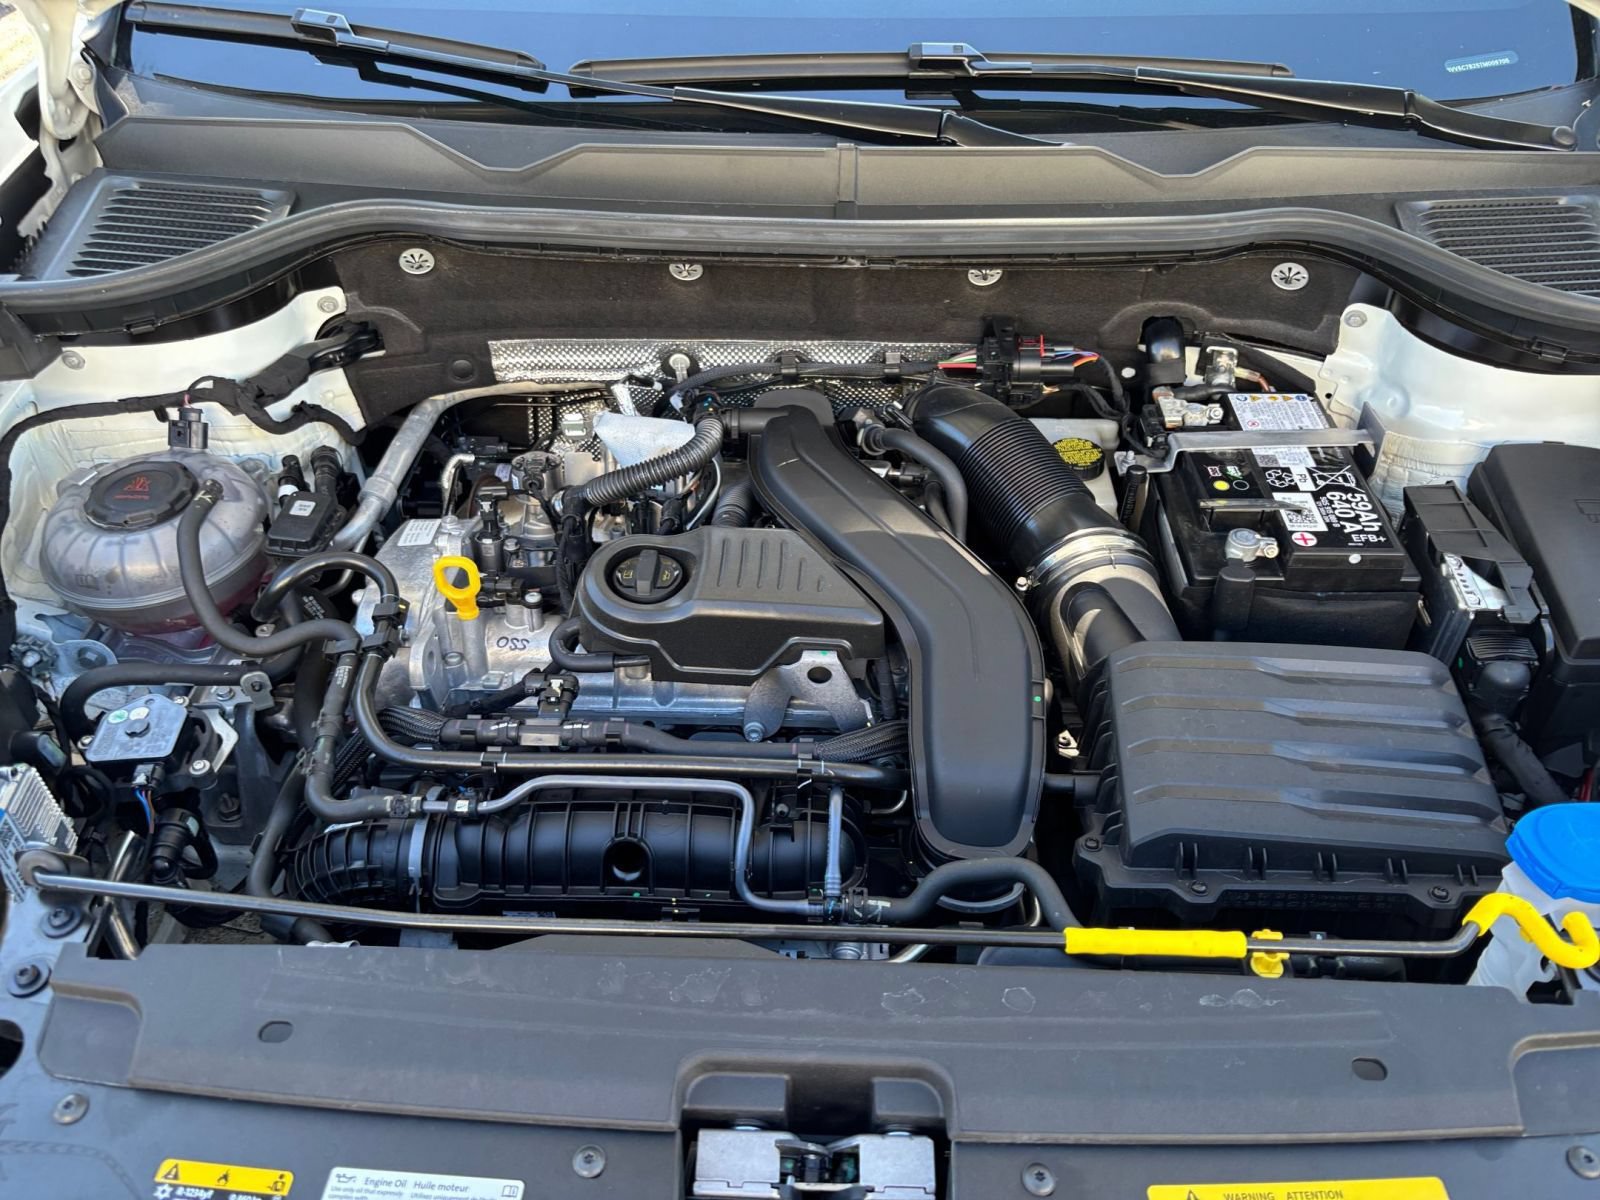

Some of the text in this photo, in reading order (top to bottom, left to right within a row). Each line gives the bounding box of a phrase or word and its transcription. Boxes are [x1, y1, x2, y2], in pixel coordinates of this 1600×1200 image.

[1296, 473, 1307, 483] Pb
[1326, 491, 1356, 518] 640
[1347, 492, 1382, 531] 59Ah
[1339, 521, 1363, 533] A
[1351, 534, 1387, 542] EFB+
[364, 1176, 407, 1189] Engine Oil
[413, 1180, 469, 1192] Huile moteur
[1223, 1190, 1344, 1200] WARNING ATTENTION
